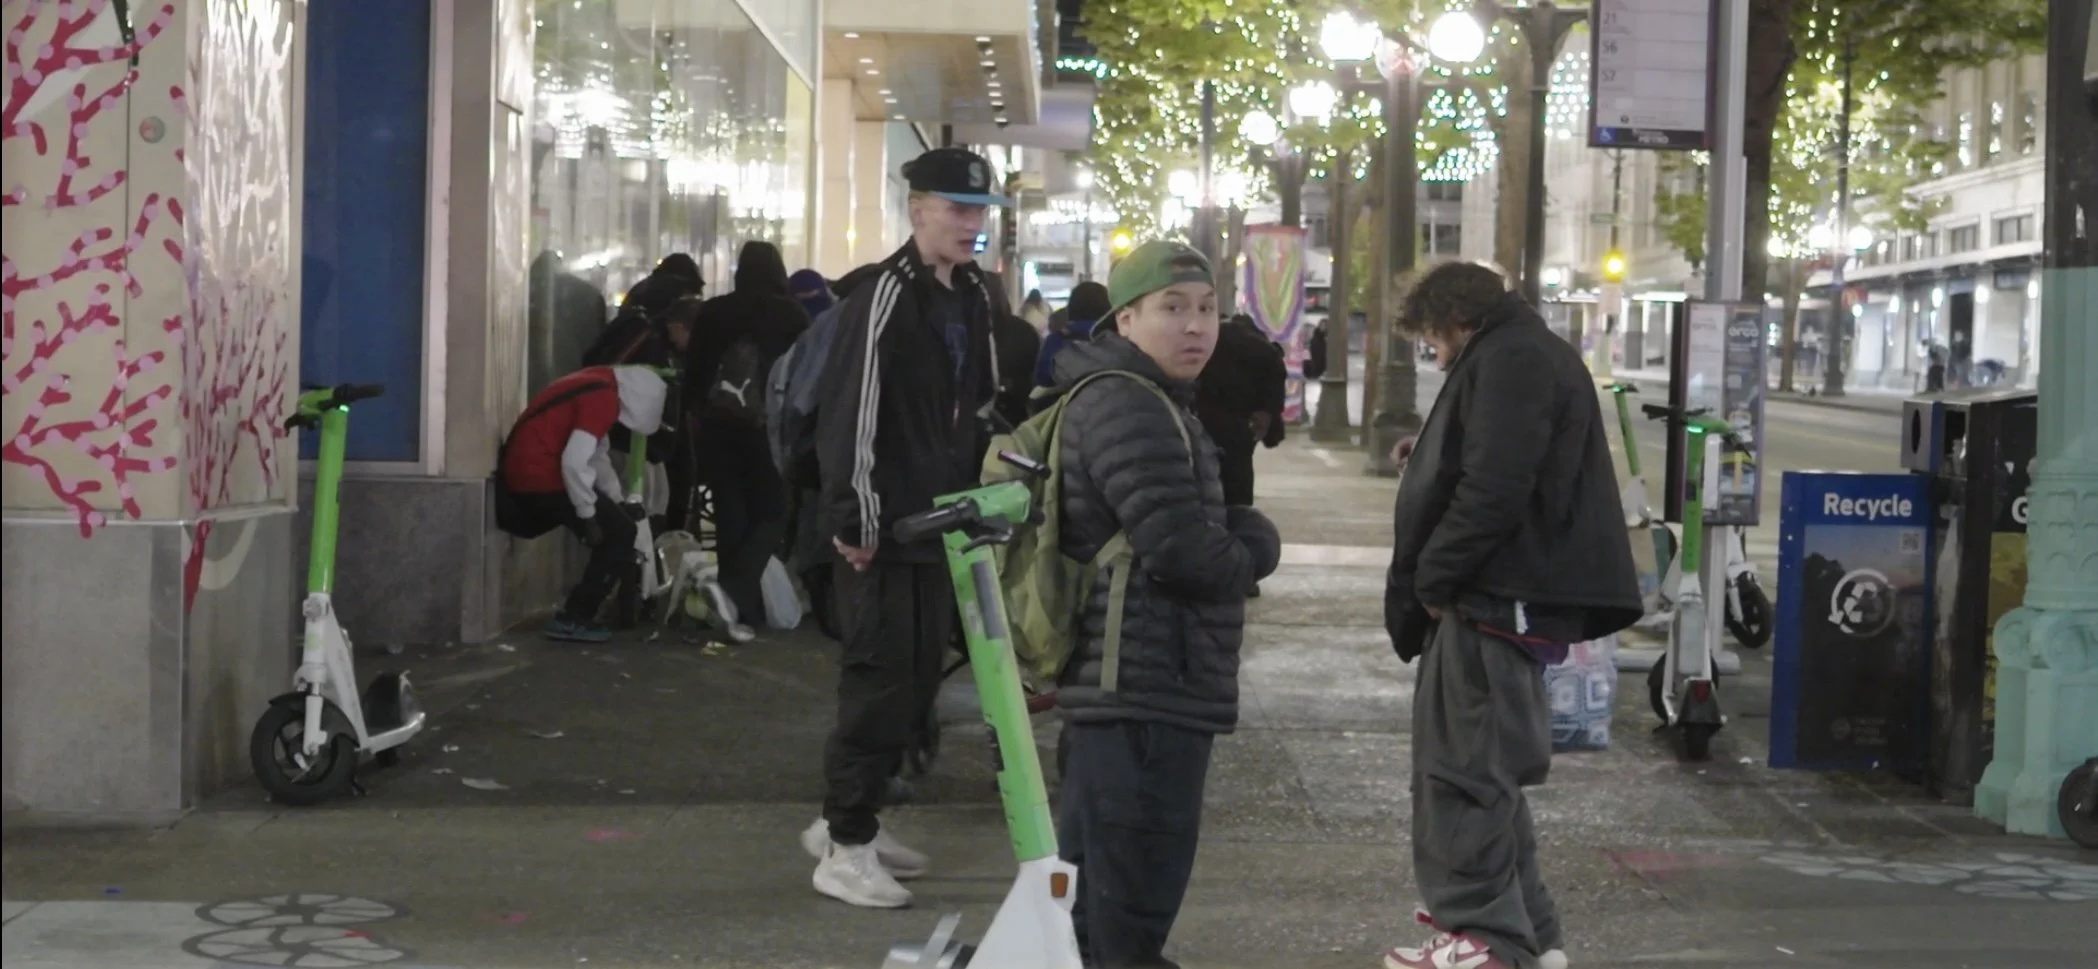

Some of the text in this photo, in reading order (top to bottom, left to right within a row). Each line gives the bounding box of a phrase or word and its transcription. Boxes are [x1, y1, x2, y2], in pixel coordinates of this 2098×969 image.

[1603, 12, 1617, 25] 21
[1602, 41, 1618, 55] 56
[1601, 70, 1617, 83] 57
[968, 162, 984, 188] S
[1728, 326, 1760, 337] orca
[1823, 492, 1913, 520] Recycle
